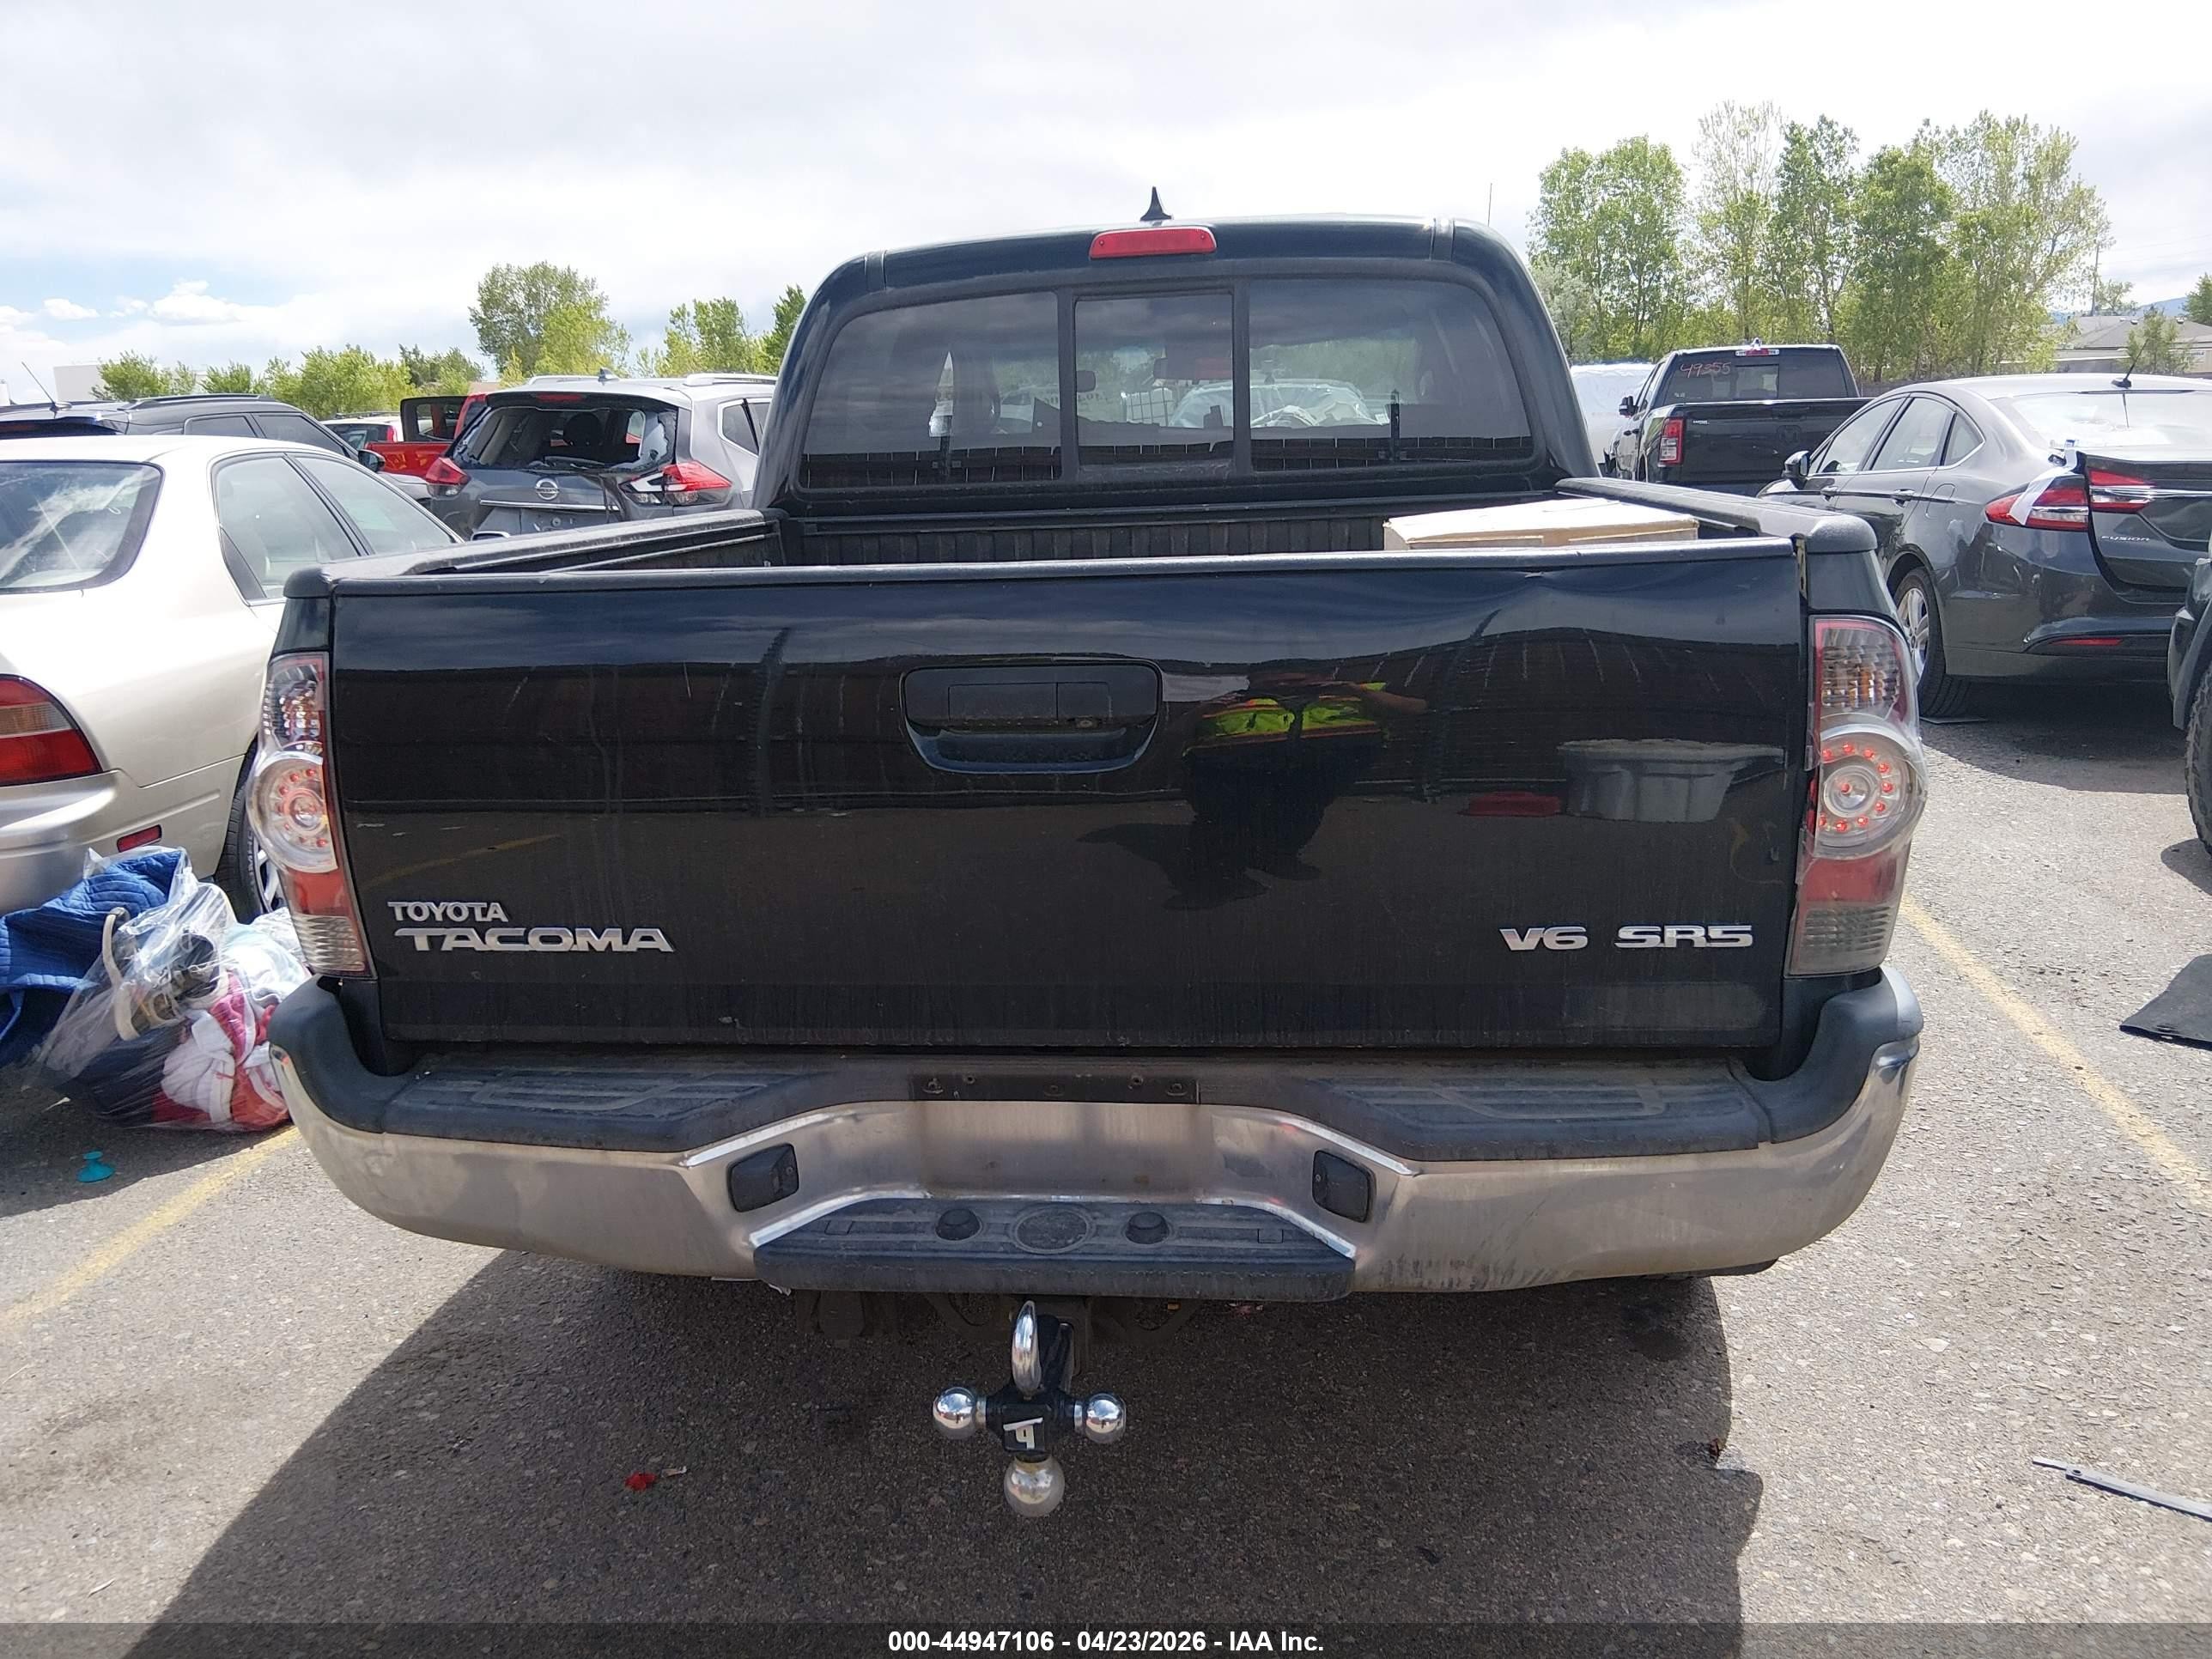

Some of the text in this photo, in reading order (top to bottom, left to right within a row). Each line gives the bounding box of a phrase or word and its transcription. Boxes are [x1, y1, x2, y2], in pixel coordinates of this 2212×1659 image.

[1680, 362, 1732, 378] 49355
[388, 902, 508, 922] TOYOTA
[394, 927, 674, 952] TACOMA
[1499, 925, 1753, 951] V6 SR5
